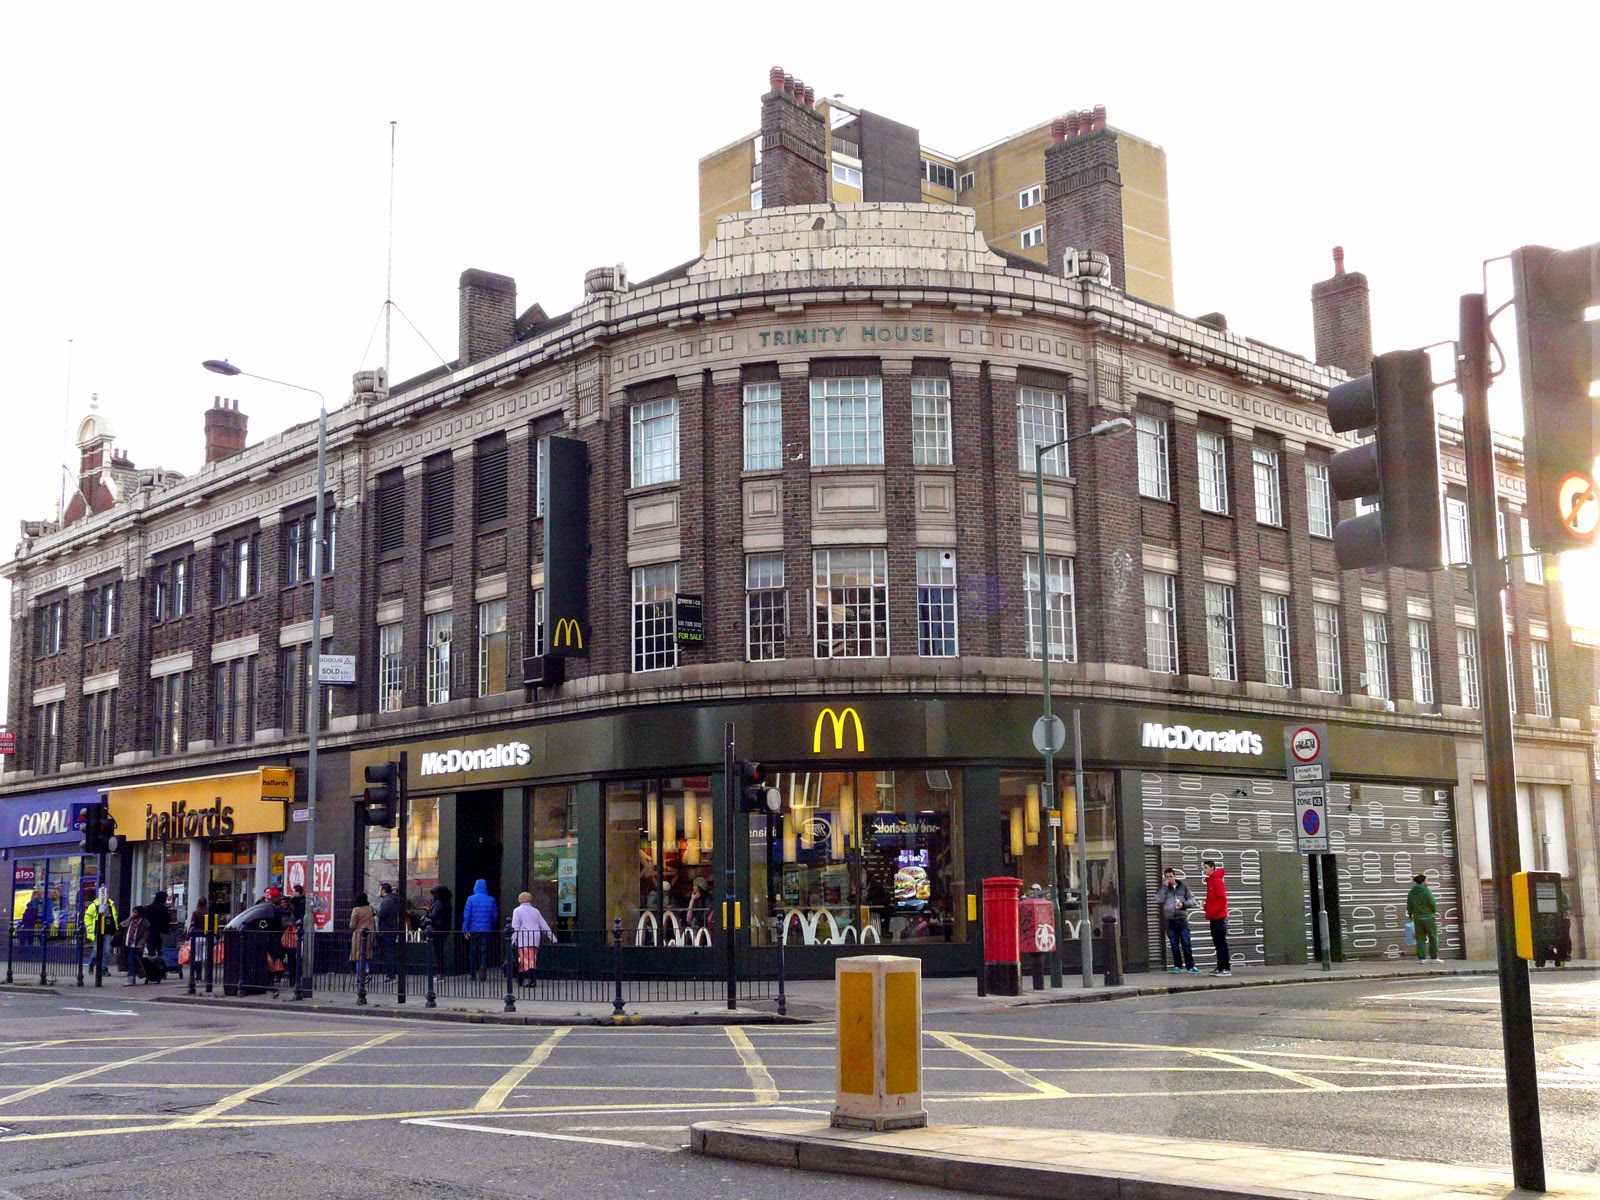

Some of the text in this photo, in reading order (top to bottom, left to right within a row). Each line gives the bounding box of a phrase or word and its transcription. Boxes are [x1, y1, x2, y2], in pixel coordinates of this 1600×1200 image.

[759, 326, 934, 347] TRINITY HOUSE
[678, 632, 688, 640] FOR
[1142, 722, 1263, 756] McDonald's
[421, 741, 531, 776] McDonald's
[1294, 766, 1312, 774] Except
[262, 779, 289, 787] halfords
[19, 809, 68, 837] CORAL
[146, 796, 235, 841] halfords
[899, 855, 926, 863] Big Tasty
[313, 862, 332, 892] £12
